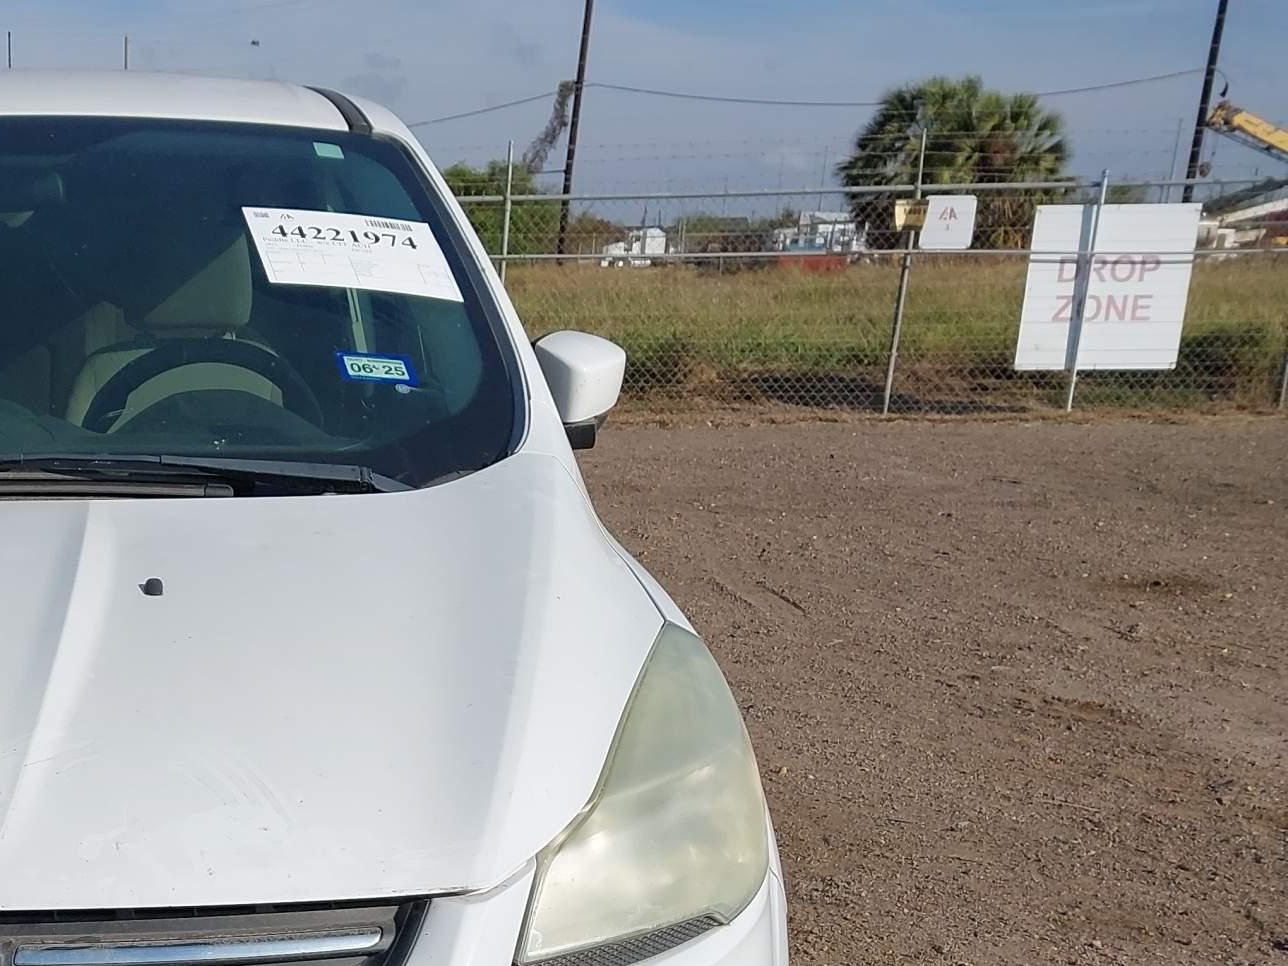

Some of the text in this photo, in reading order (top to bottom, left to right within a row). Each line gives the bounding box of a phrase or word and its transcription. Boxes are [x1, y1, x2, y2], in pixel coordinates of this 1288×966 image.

[271, 224, 417, 250] 44221974
[1056, 254, 1161, 283] DROP
[1051, 294, 1154, 323] ZONE
[349, 362, 406, 377] 06 25
